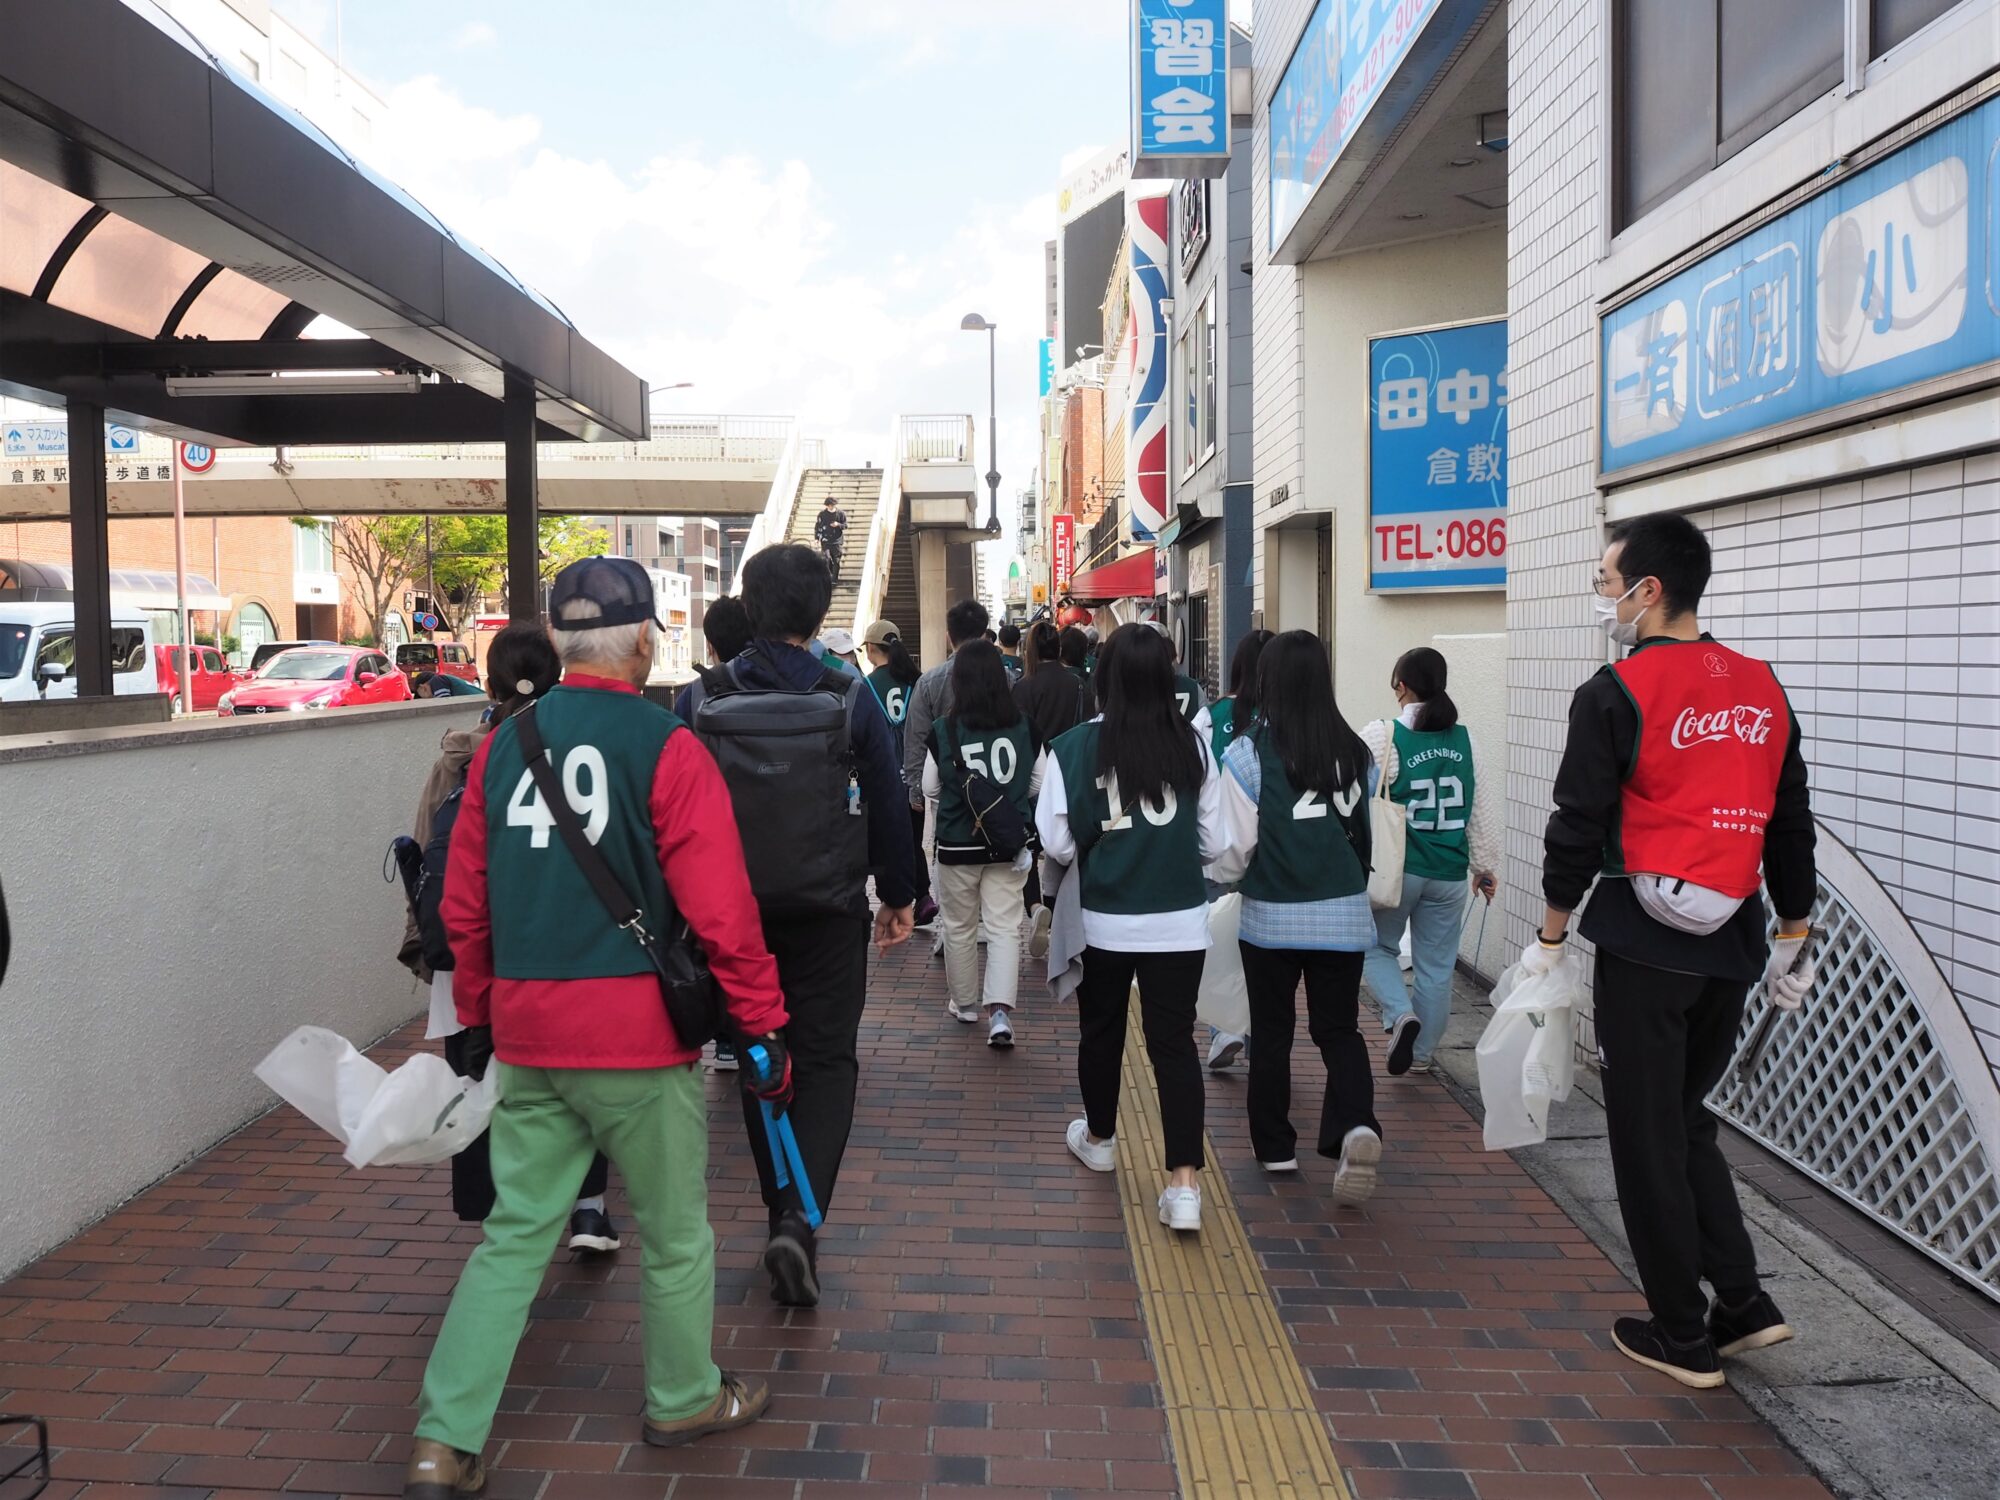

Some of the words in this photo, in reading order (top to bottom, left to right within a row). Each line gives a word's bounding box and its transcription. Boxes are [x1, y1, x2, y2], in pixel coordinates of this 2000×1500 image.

[1152, 0, 1214, 144] 習会
[1861, 221, 1917, 335] 小
[1705, 273, 1788, 397] 個別
[1378, 364, 1508, 431] 田中
[187, 445, 207, 462] 40
[1427, 443, 1502, 486] 倉敷
[1375, 518, 1506, 562] TEL:086
[960, 737, 1017, 785] 50
[506, 744, 609, 849] 49
[1406, 775, 1466, 830] 22
